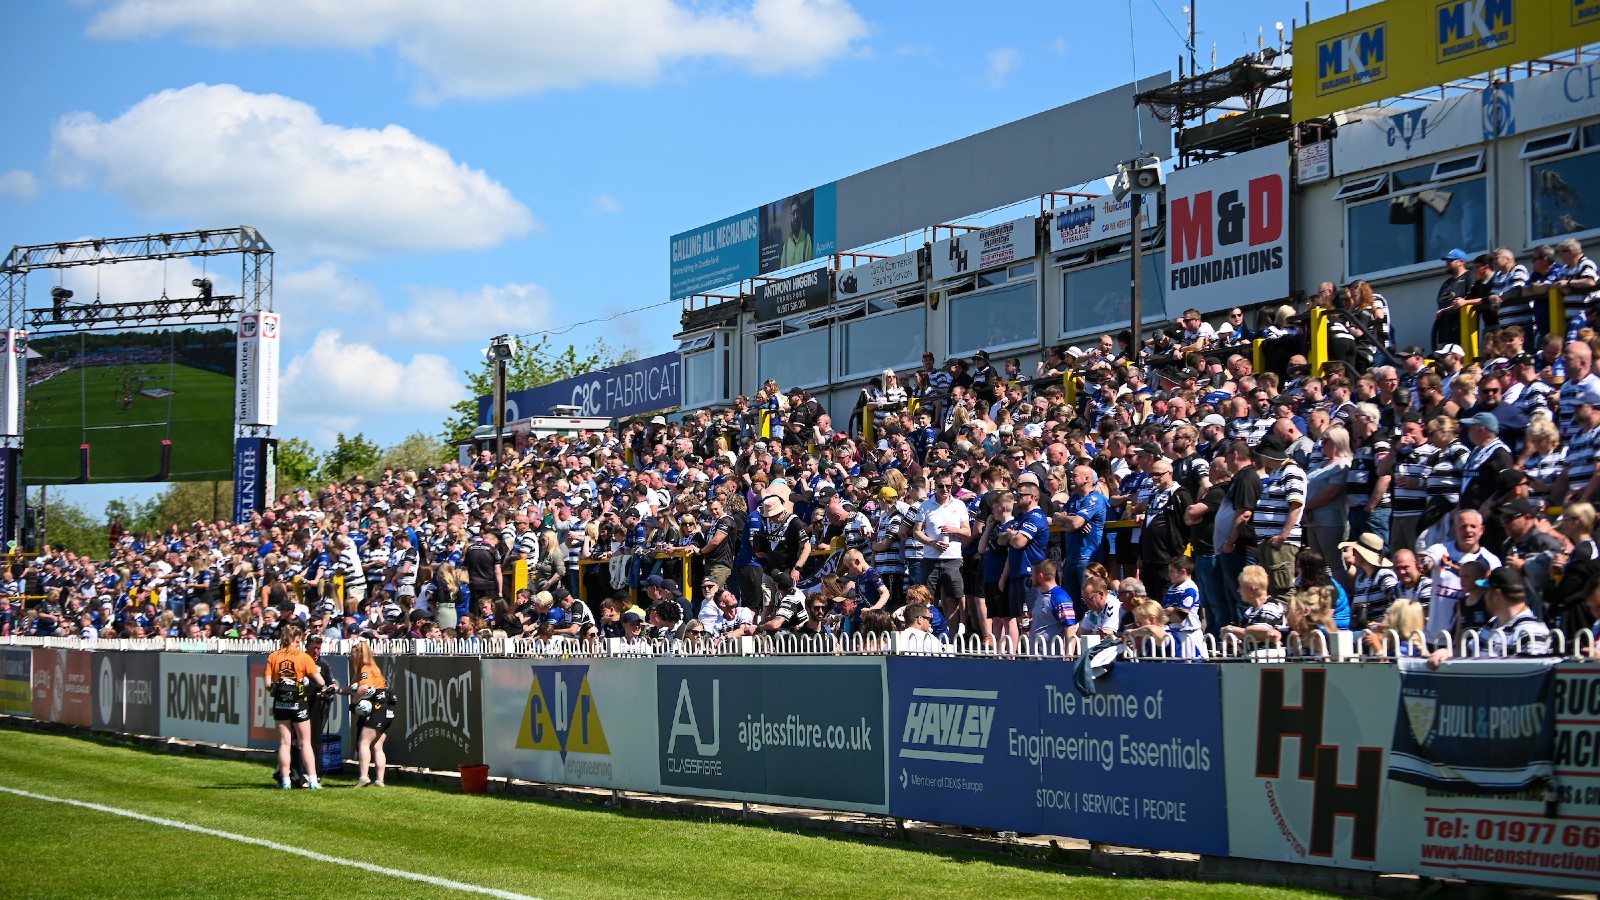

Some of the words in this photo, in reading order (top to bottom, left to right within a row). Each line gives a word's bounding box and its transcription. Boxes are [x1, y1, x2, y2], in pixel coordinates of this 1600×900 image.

[1440, 0, 1512, 45] MKM
[1319, 27, 1384, 80] MKM
[1322, 75, 1351, 91] BUILDING
[1353, 66, 1382, 82] SUPPLIES
[672, 234, 701, 262] CALLING
[702, 229, 715, 253] ALL
[716, 216, 758, 249] MECHANICS
[1171, 173, 1283, 264] M&D
[763, 280, 792, 299] ANTHONY
[792, 271, 818, 290] HIGGINS
[1171, 245, 1284, 291] FOUNDATIONS
[242, 322, 256, 332] TIP
[240, 341, 248, 385] Services
[239, 388, 248, 421] Tanker
[572, 380, 601, 416] C&C
[605, 361, 680, 411] FABRICAT
[167, 673, 240, 725] RONSEAL
[404, 669, 472, 739] IMPACT
[667, 678, 720, 756] AJ
[1045, 684, 1076, 716] The
[1082, 695, 1138, 719] Home
[1144, 689, 1163, 720] of
[408, 727, 470, 753] PERFORMANCE
[738, 713, 872, 752] ajglassfibre.co.uk
[902, 702, 995, 748] HAYLEY
[566, 758, 613, 781] engineering
[1008, 727, 1114, 771] Engineering
[1120, 733, 1210, 771] Essentials
[911, 774, 935, 787] Member
[937, 777, 944, 787] of
[944, 777, 961, 790] DEXIS
[962, 779, 984, 793] Europe
[1036, 788, 1071, 810] STOCK
[1082, 792, 1130, 817] SERVICE
[1143, 799, 1186, 822] PEOPLE
[1265, 780, 1307, 860] CONSTRUCTION
[1424, 816, 1469, 839] Tel:
[1476, 818, 1557, 845] 01977
